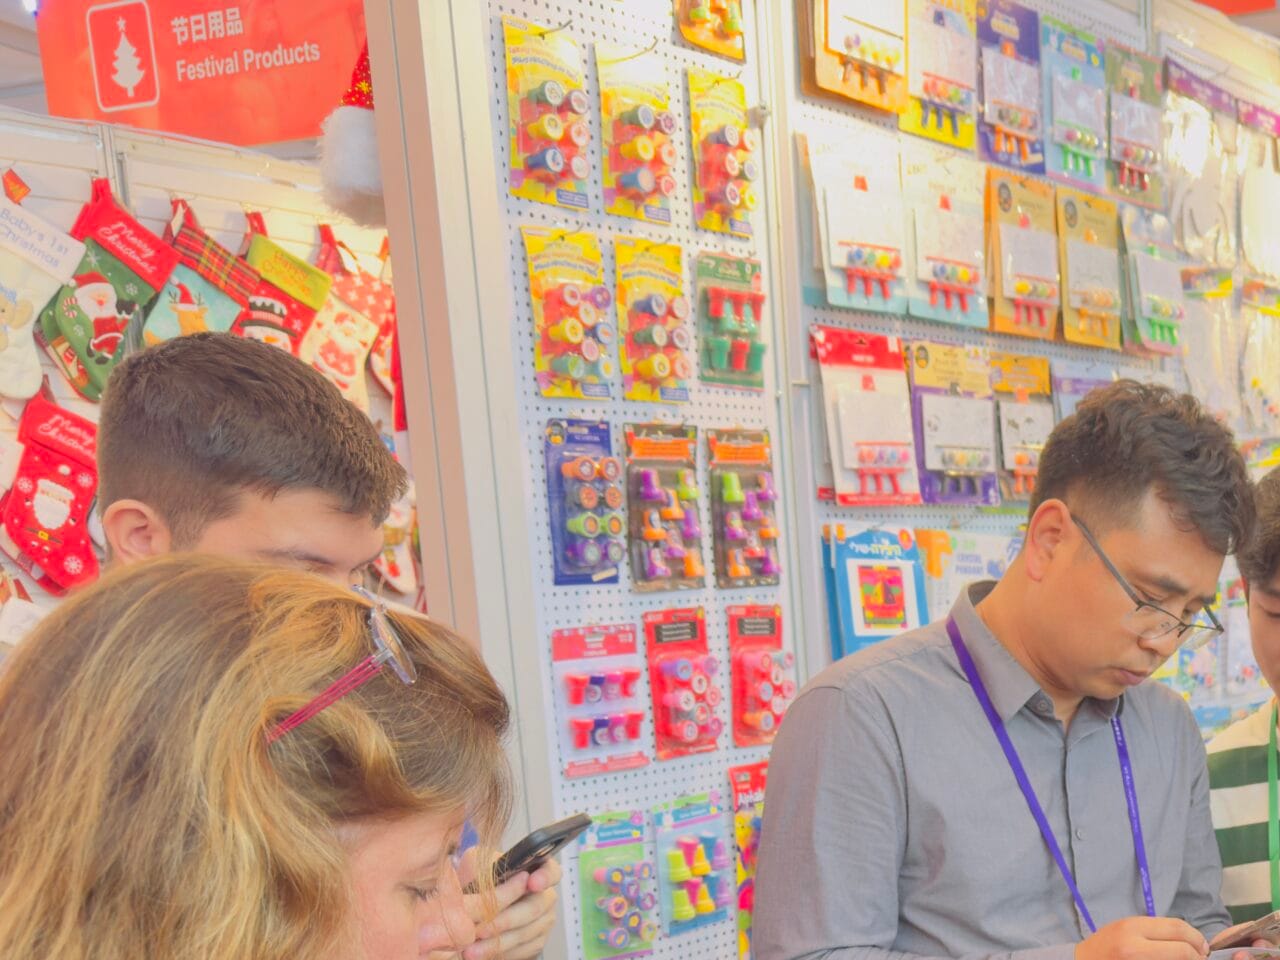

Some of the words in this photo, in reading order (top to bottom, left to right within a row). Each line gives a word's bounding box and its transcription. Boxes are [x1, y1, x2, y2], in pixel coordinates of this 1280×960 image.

[171, 7, 243, 45] 节日用品
[176, 51, 239, 82] Festival
[243, 41, 321, 71] Products
[110, 222, 154, 259] Merry
[49, 413, 94, 446] Merry
